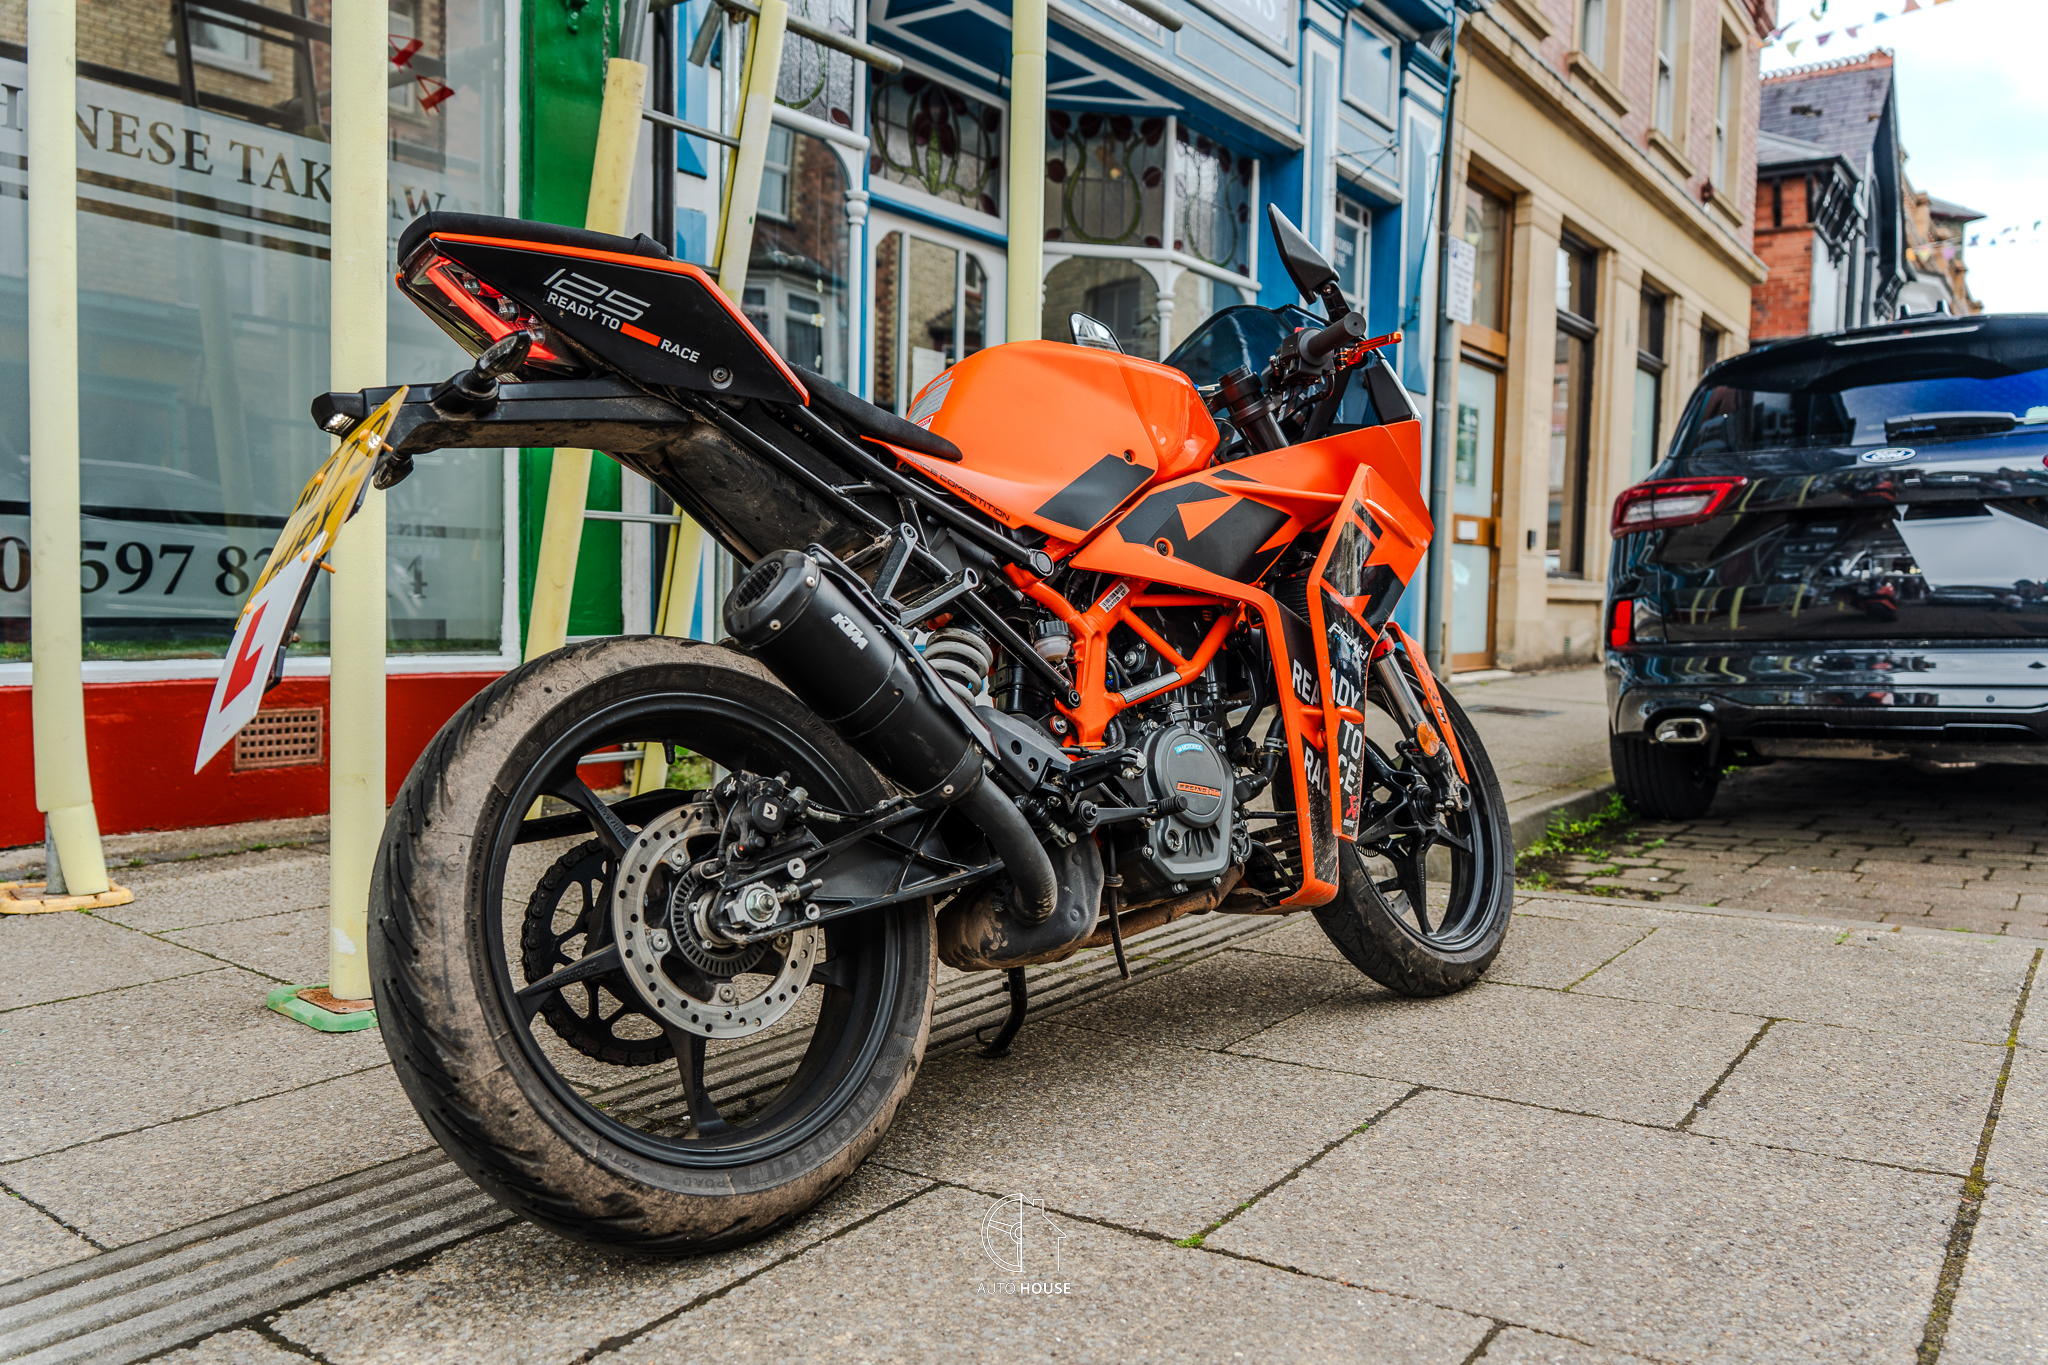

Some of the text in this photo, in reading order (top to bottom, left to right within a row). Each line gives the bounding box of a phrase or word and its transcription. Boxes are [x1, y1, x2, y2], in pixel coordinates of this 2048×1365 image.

[543, 268, 651, 321] 125
[547, 291, 700, 363] READY TO RACE
[906, 453, 1010, 521] RACE COMPETITION
[219, 600, 269, 713] L
[831, 612, 869, 650] KTM
[749, 1082, 881, 1184] MICHELIN
